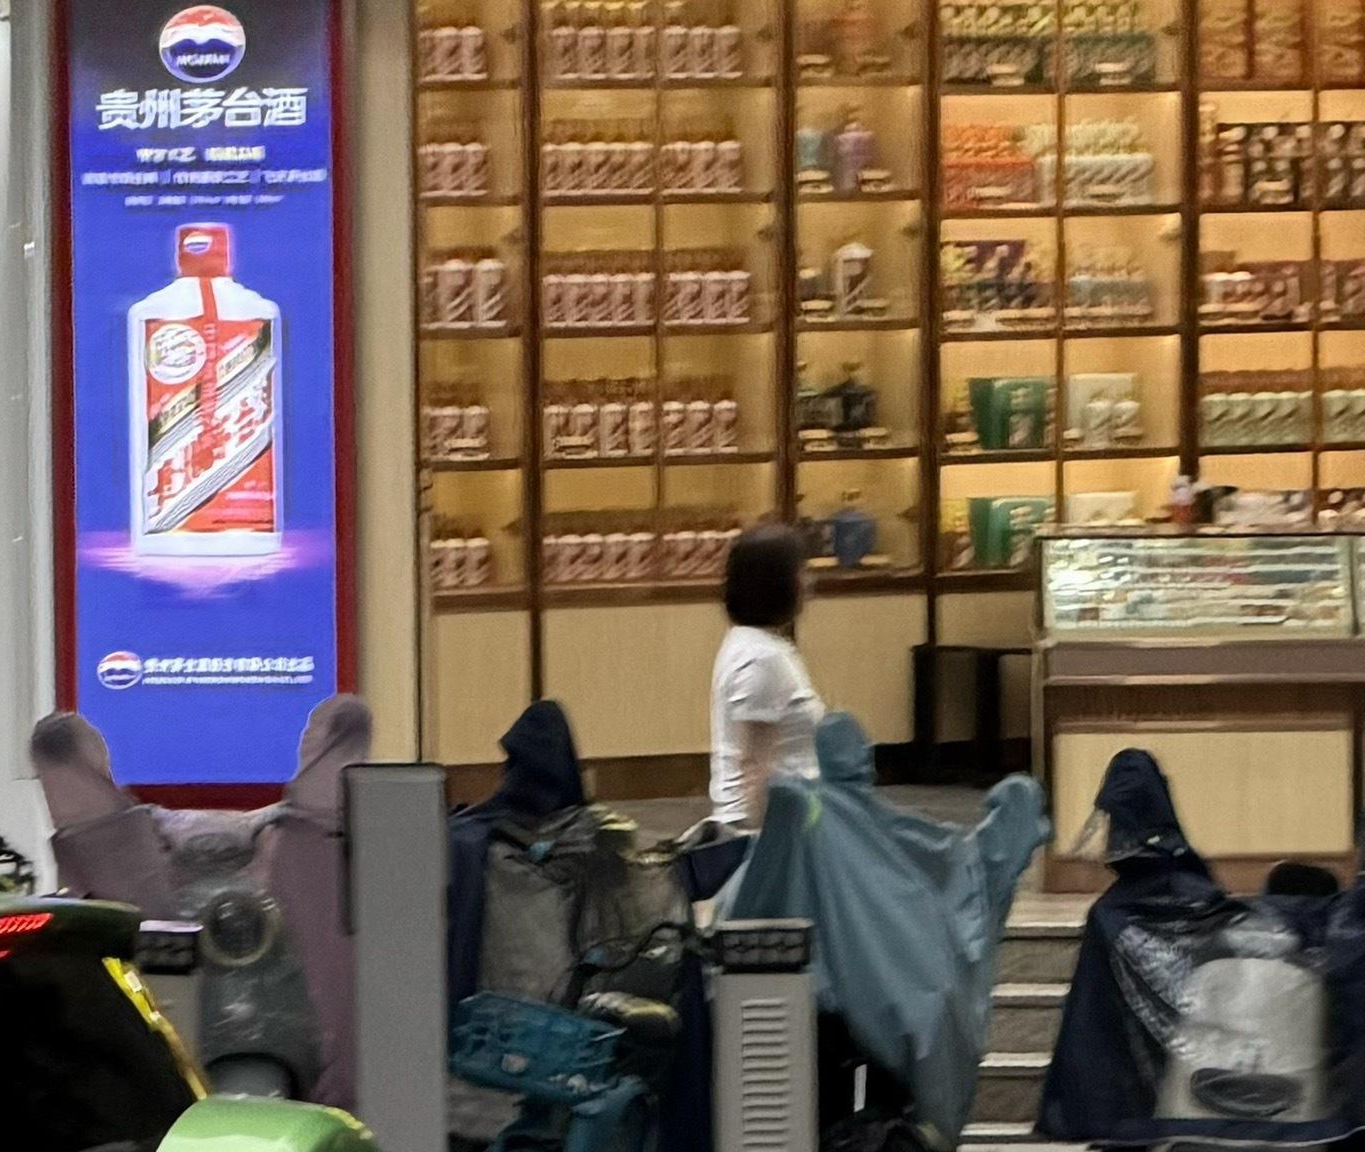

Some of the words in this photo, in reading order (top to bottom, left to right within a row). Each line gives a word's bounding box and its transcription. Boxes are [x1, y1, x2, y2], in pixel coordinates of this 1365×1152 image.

[96, 87, 308, 130] 贵州茅台酒
